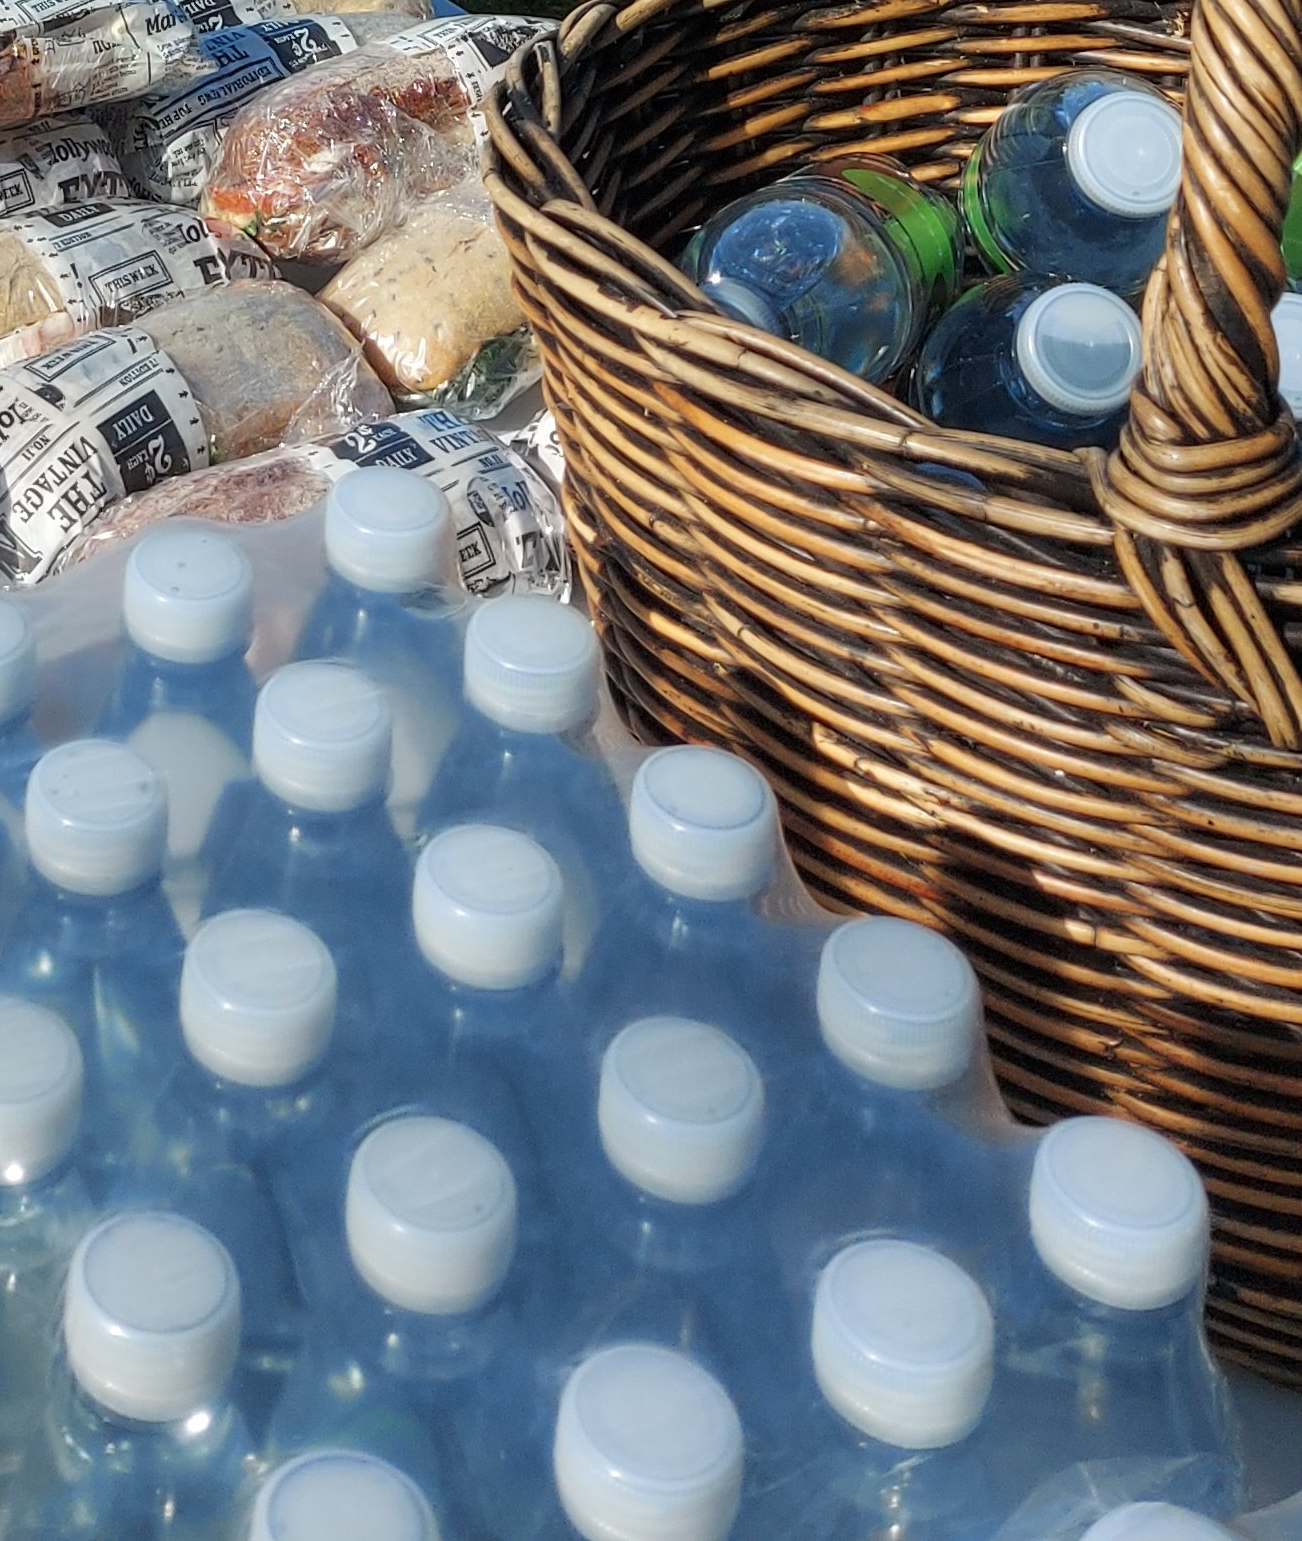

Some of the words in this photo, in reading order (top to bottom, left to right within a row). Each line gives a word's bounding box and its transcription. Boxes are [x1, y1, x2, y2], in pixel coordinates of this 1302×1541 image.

[105, 274, 133, 294] THIS
[115, 405, 155, 441] DAILY
[345, 424, 375, 454] 2¢
[12, 437, 98, 524] VINTAGE
[48, 470, 108, 533] THE
[458, 541, 482, 562] EEK
